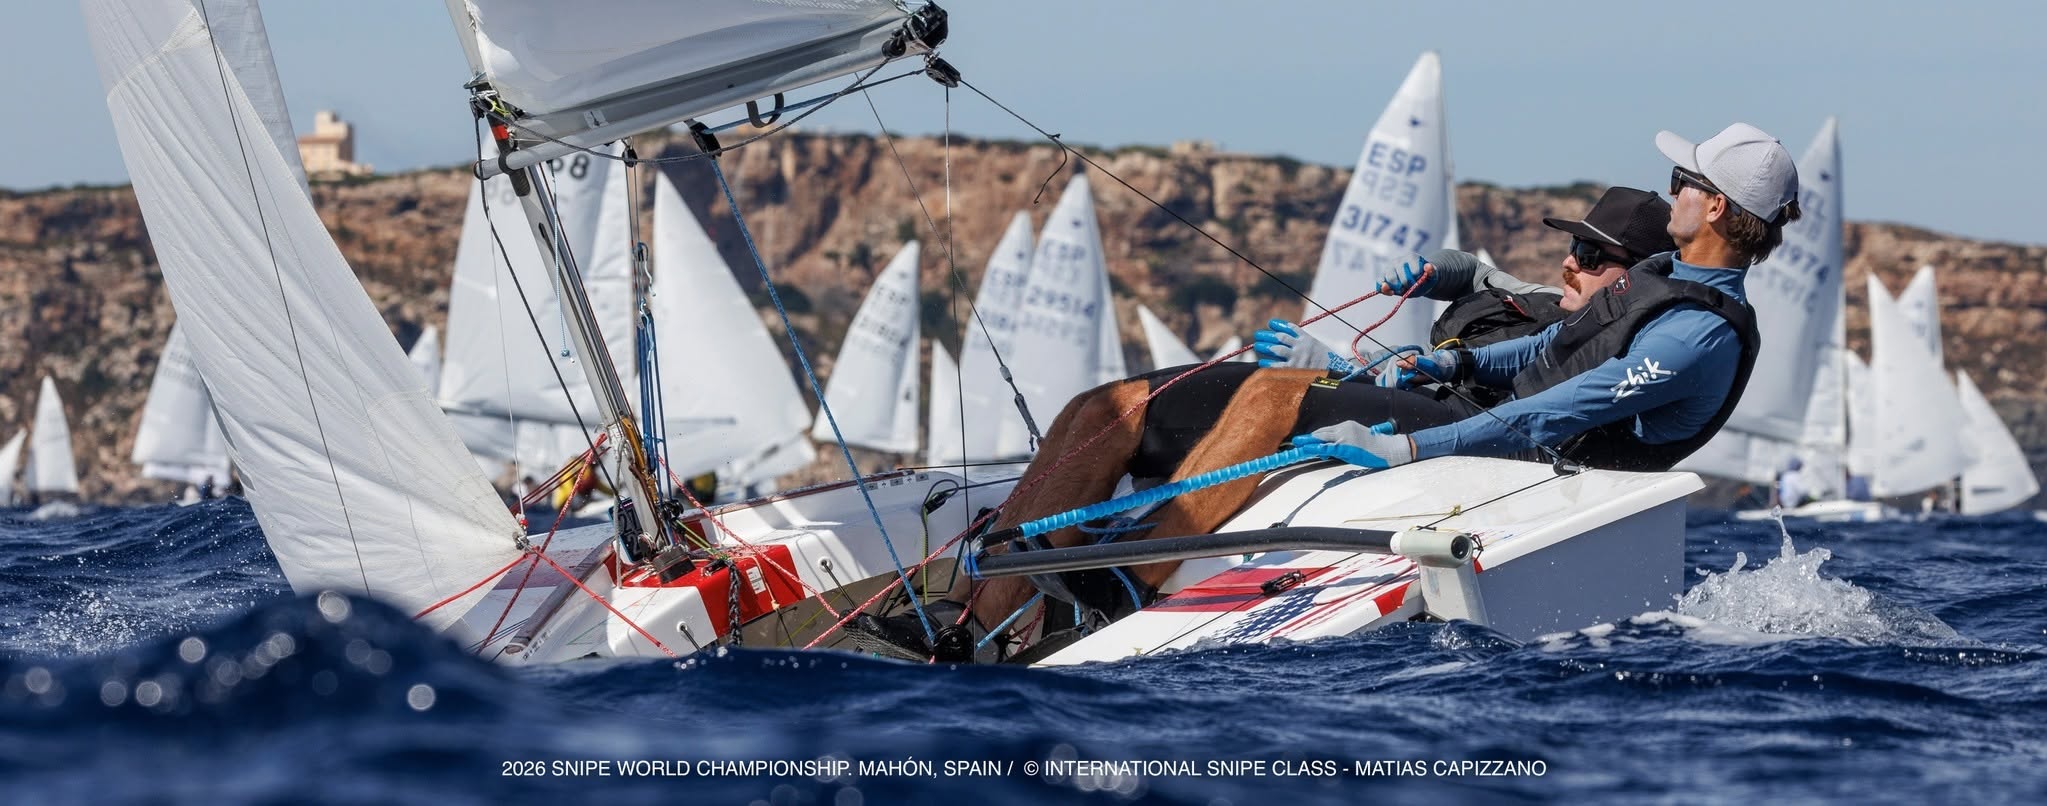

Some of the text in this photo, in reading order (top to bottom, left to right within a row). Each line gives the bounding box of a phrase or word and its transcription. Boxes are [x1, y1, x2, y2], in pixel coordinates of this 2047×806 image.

[1368, 142, 1427, 175] ESP
[1341, 204, 1431, 253] 31747
[1609, 357, 1672, 403] zhik
